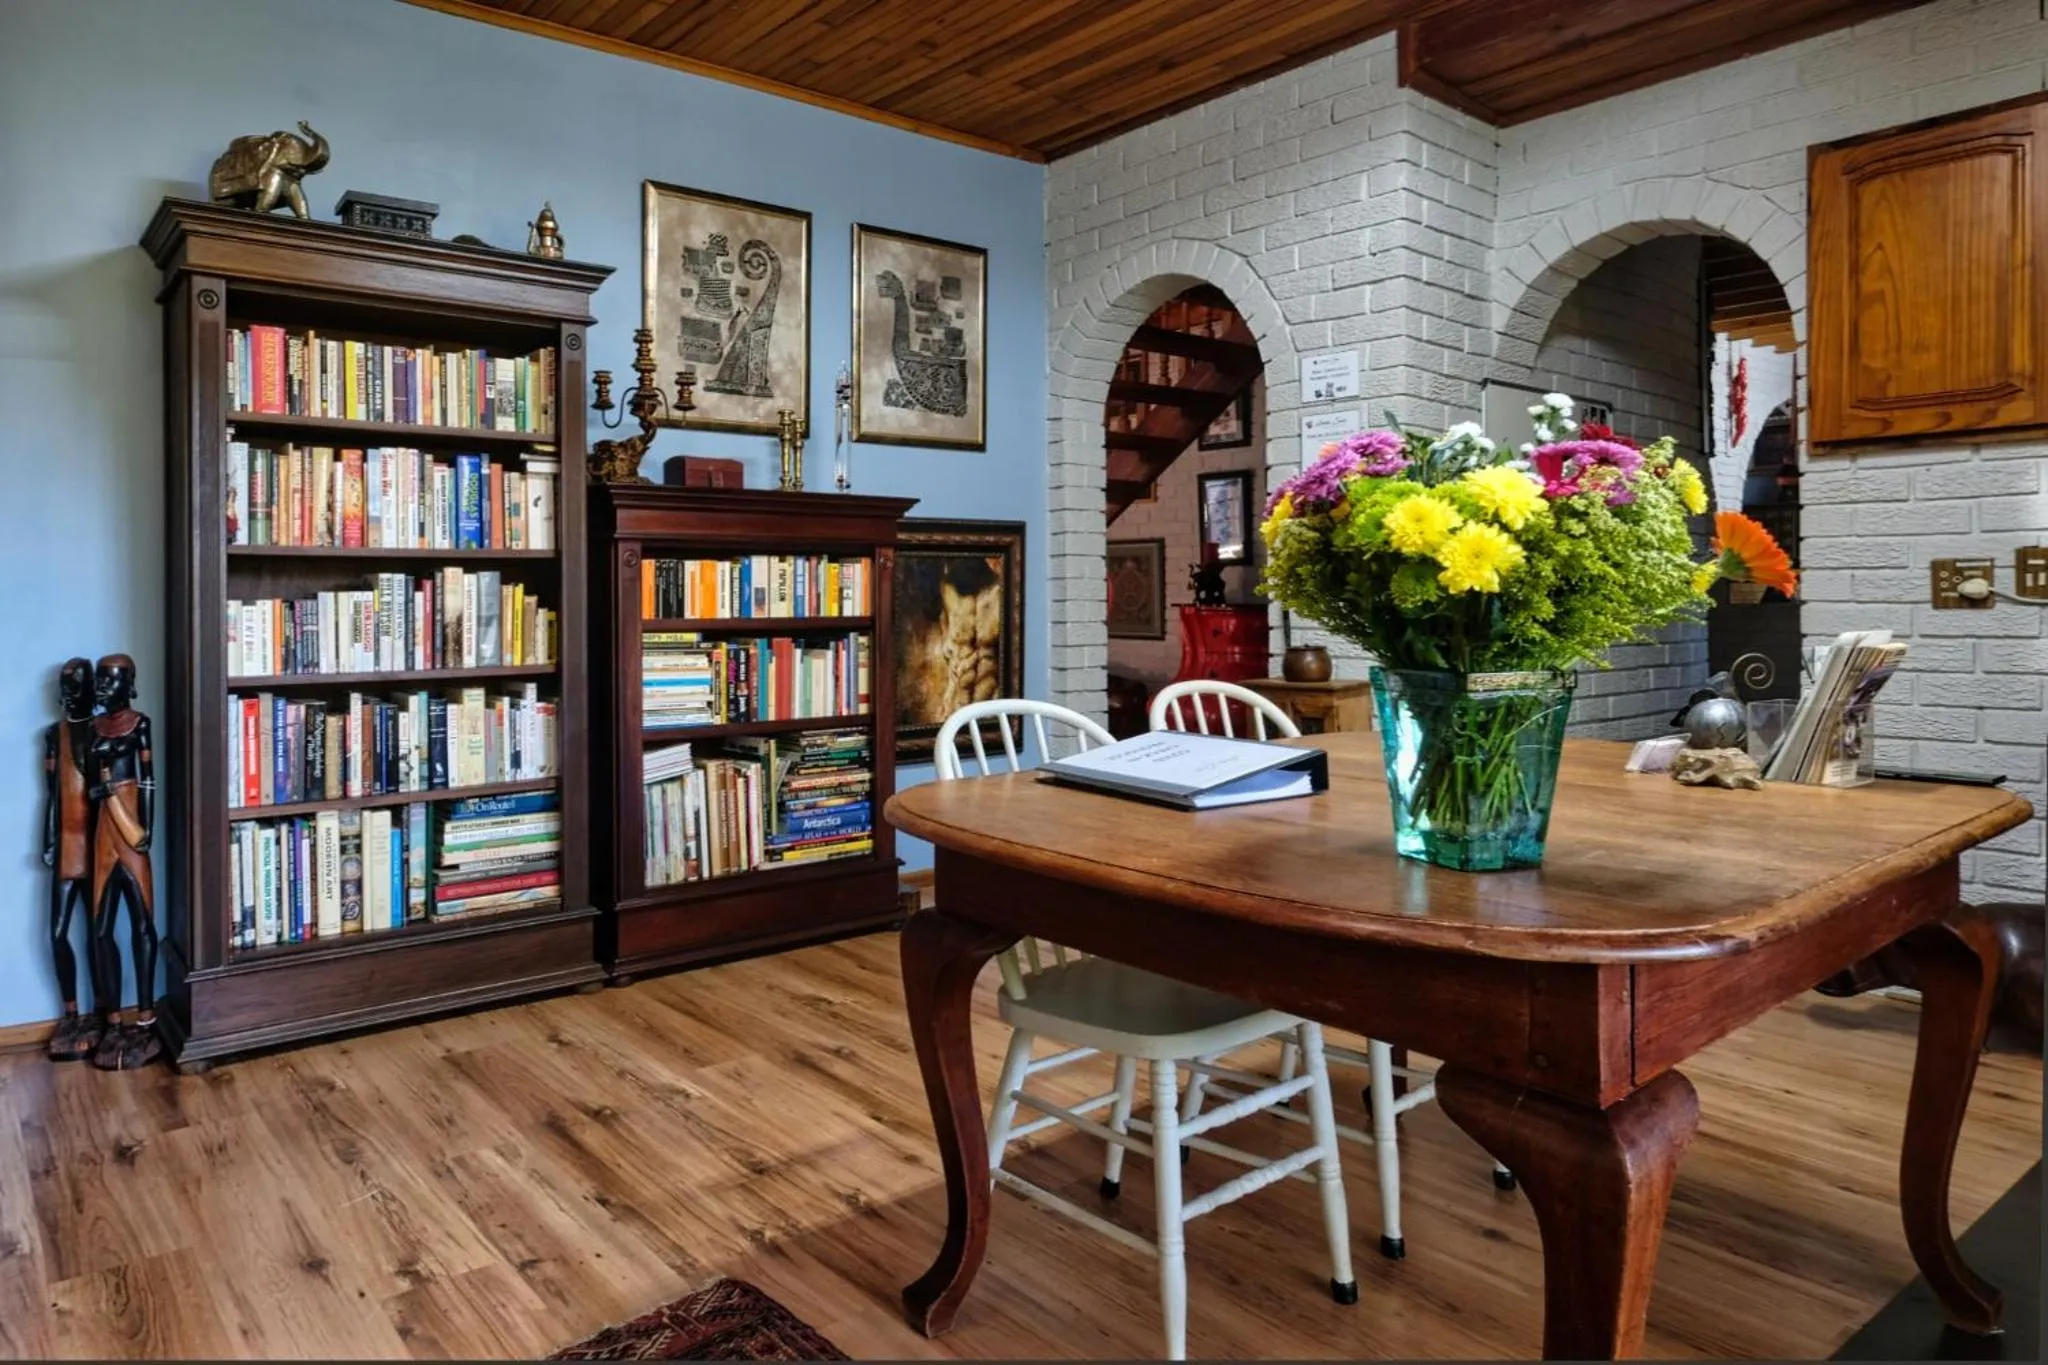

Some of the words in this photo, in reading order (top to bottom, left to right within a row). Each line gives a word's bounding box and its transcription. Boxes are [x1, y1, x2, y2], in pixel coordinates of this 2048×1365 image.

[380, 601, 393, 637] BRYSON
[803, 816, 841, 829] Antarctica
[325, 827, 333, 877] MODERN
[325, 879, 333, 901] ART
